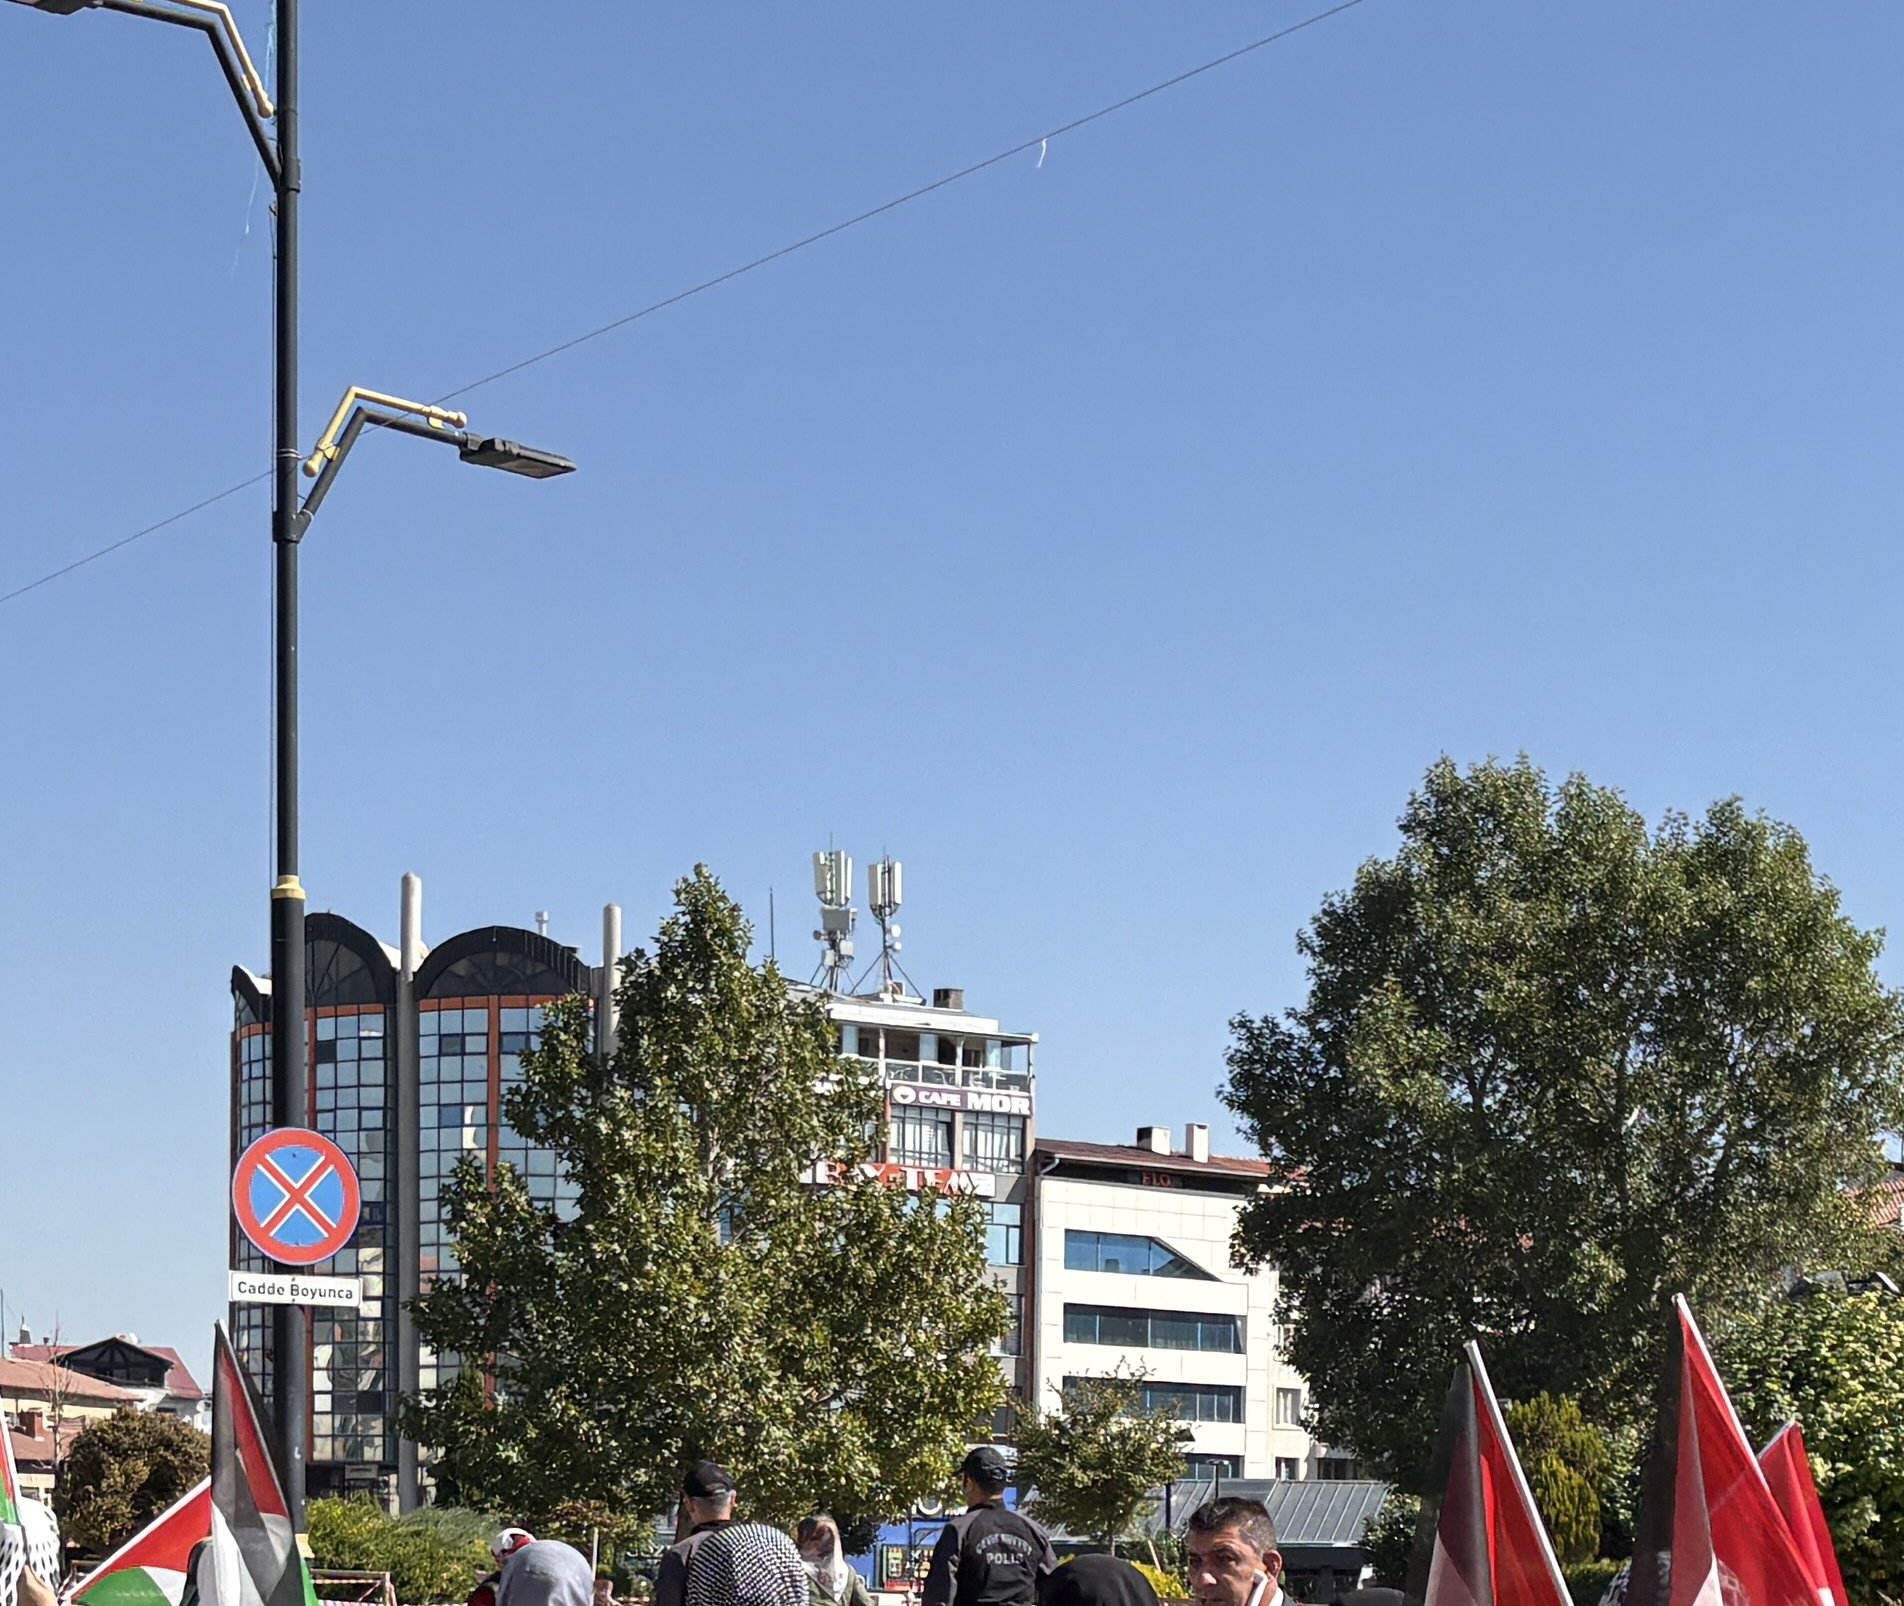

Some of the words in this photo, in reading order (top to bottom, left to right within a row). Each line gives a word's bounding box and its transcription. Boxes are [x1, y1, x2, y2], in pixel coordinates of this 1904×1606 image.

[918, 1090, 962, 1107] CAFE
[967, 1091, 1031, 1116] MOR
[237, 1280, 285, 1296] Cadde
[290, 1283, 354, 1300] Boyunca
